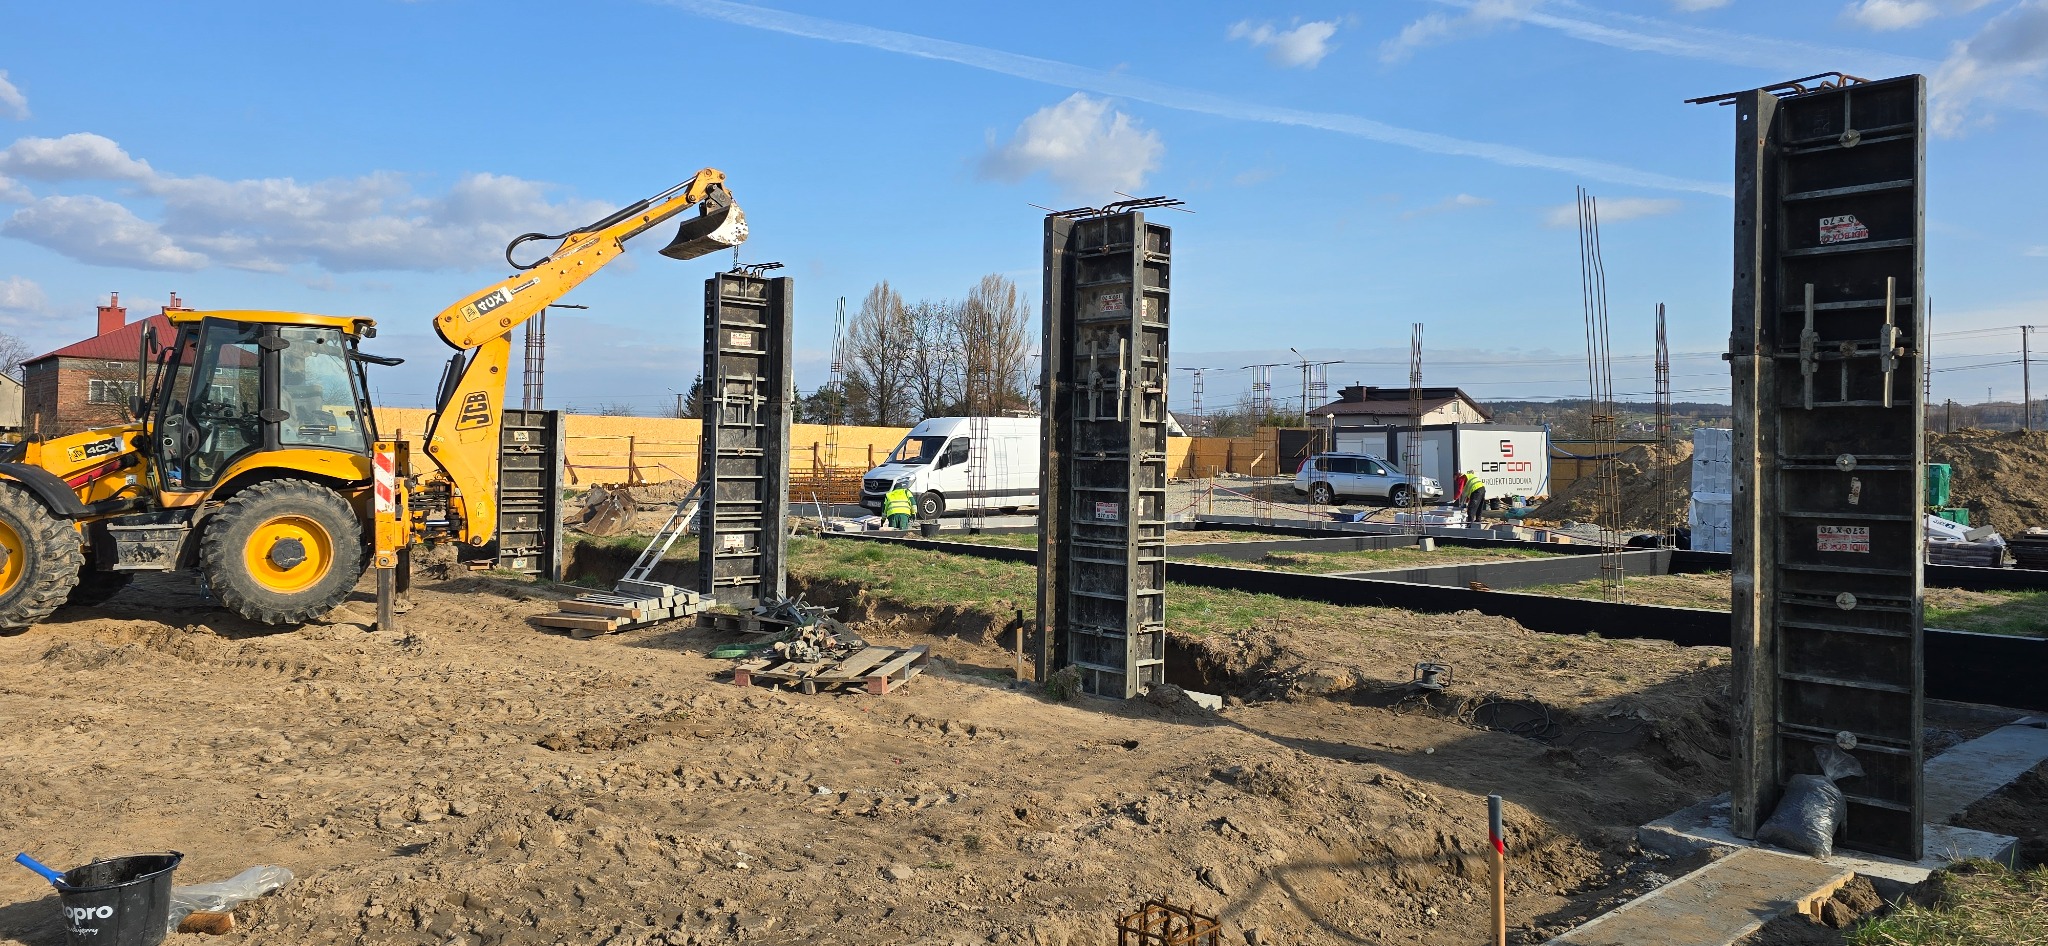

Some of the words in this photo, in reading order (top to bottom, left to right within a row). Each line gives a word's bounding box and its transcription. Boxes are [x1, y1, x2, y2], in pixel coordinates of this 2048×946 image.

[460, 392, 490, 425] JCB
[87, 442, 115, 454] 4CX
[1481, 461, 1531, 472] carcon
[1830, 543, 1848, 551] BOX
